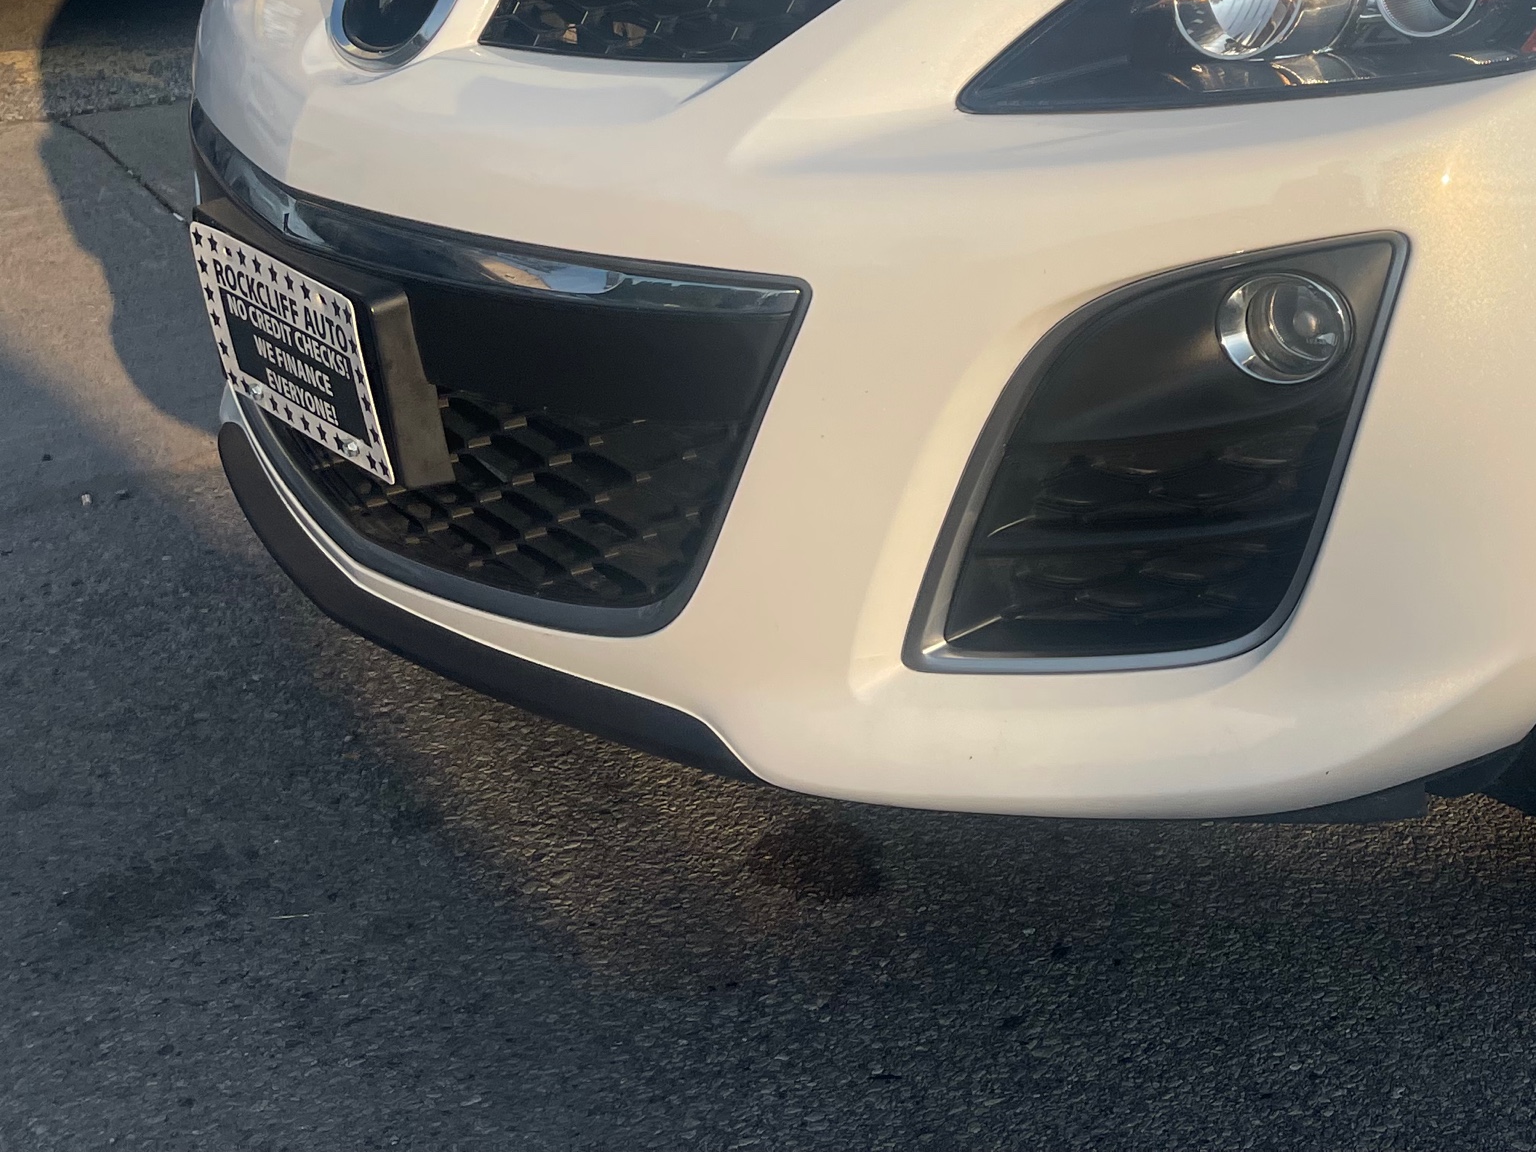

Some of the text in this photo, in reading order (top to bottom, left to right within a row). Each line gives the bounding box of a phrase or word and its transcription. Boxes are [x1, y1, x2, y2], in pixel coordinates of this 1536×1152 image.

[213, 258, 348, 353] ROCKCLIFF AUTO
[227, 293, 351, 380] NO CREDIT CHECKS!
[253, 334, 334, 397] WE FINANCE
[265, 367, 340, 426] EVERYONE!
